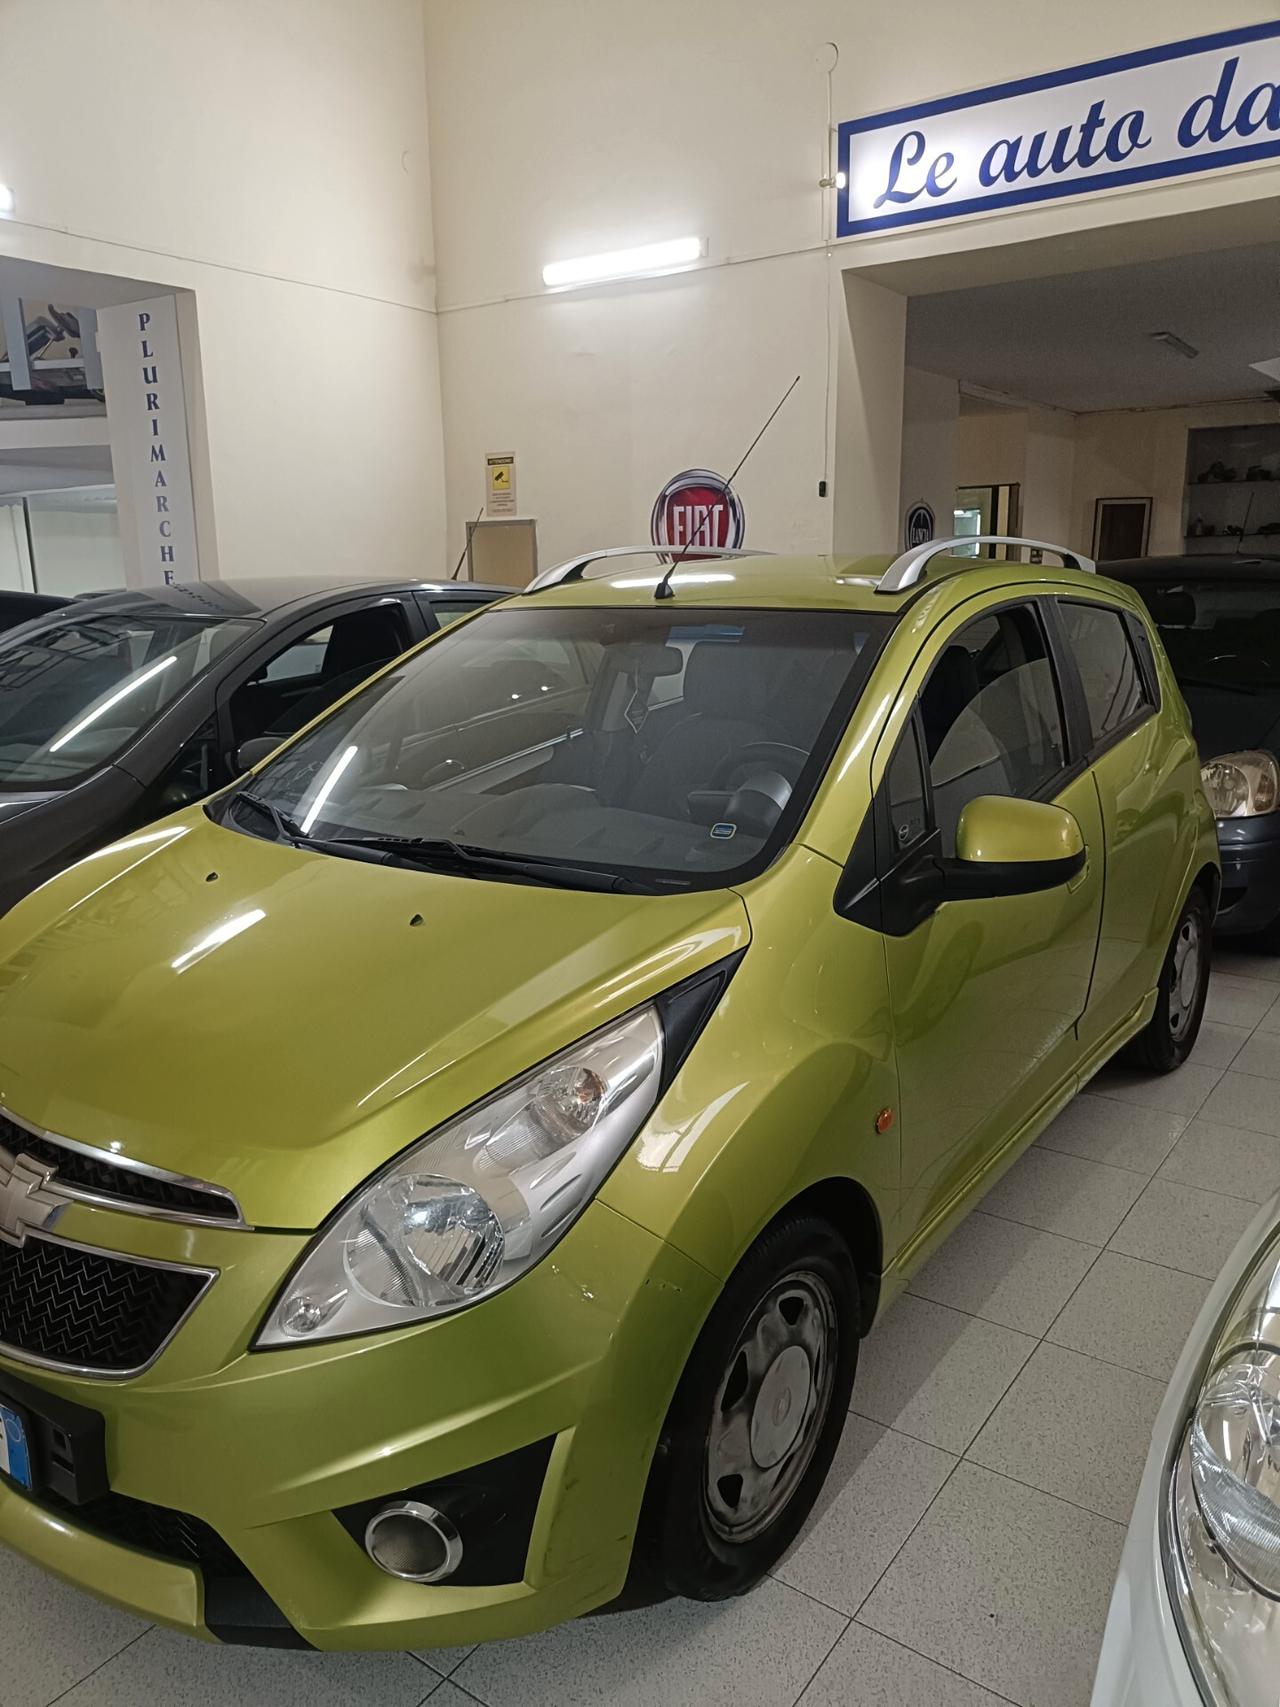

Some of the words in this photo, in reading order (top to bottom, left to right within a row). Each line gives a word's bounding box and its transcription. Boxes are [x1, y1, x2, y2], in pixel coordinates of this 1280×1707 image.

[873, 130, 957, 208] Le
[978, 99, 1152, 188] auto
[672, 504, 724, 547] FIAT
